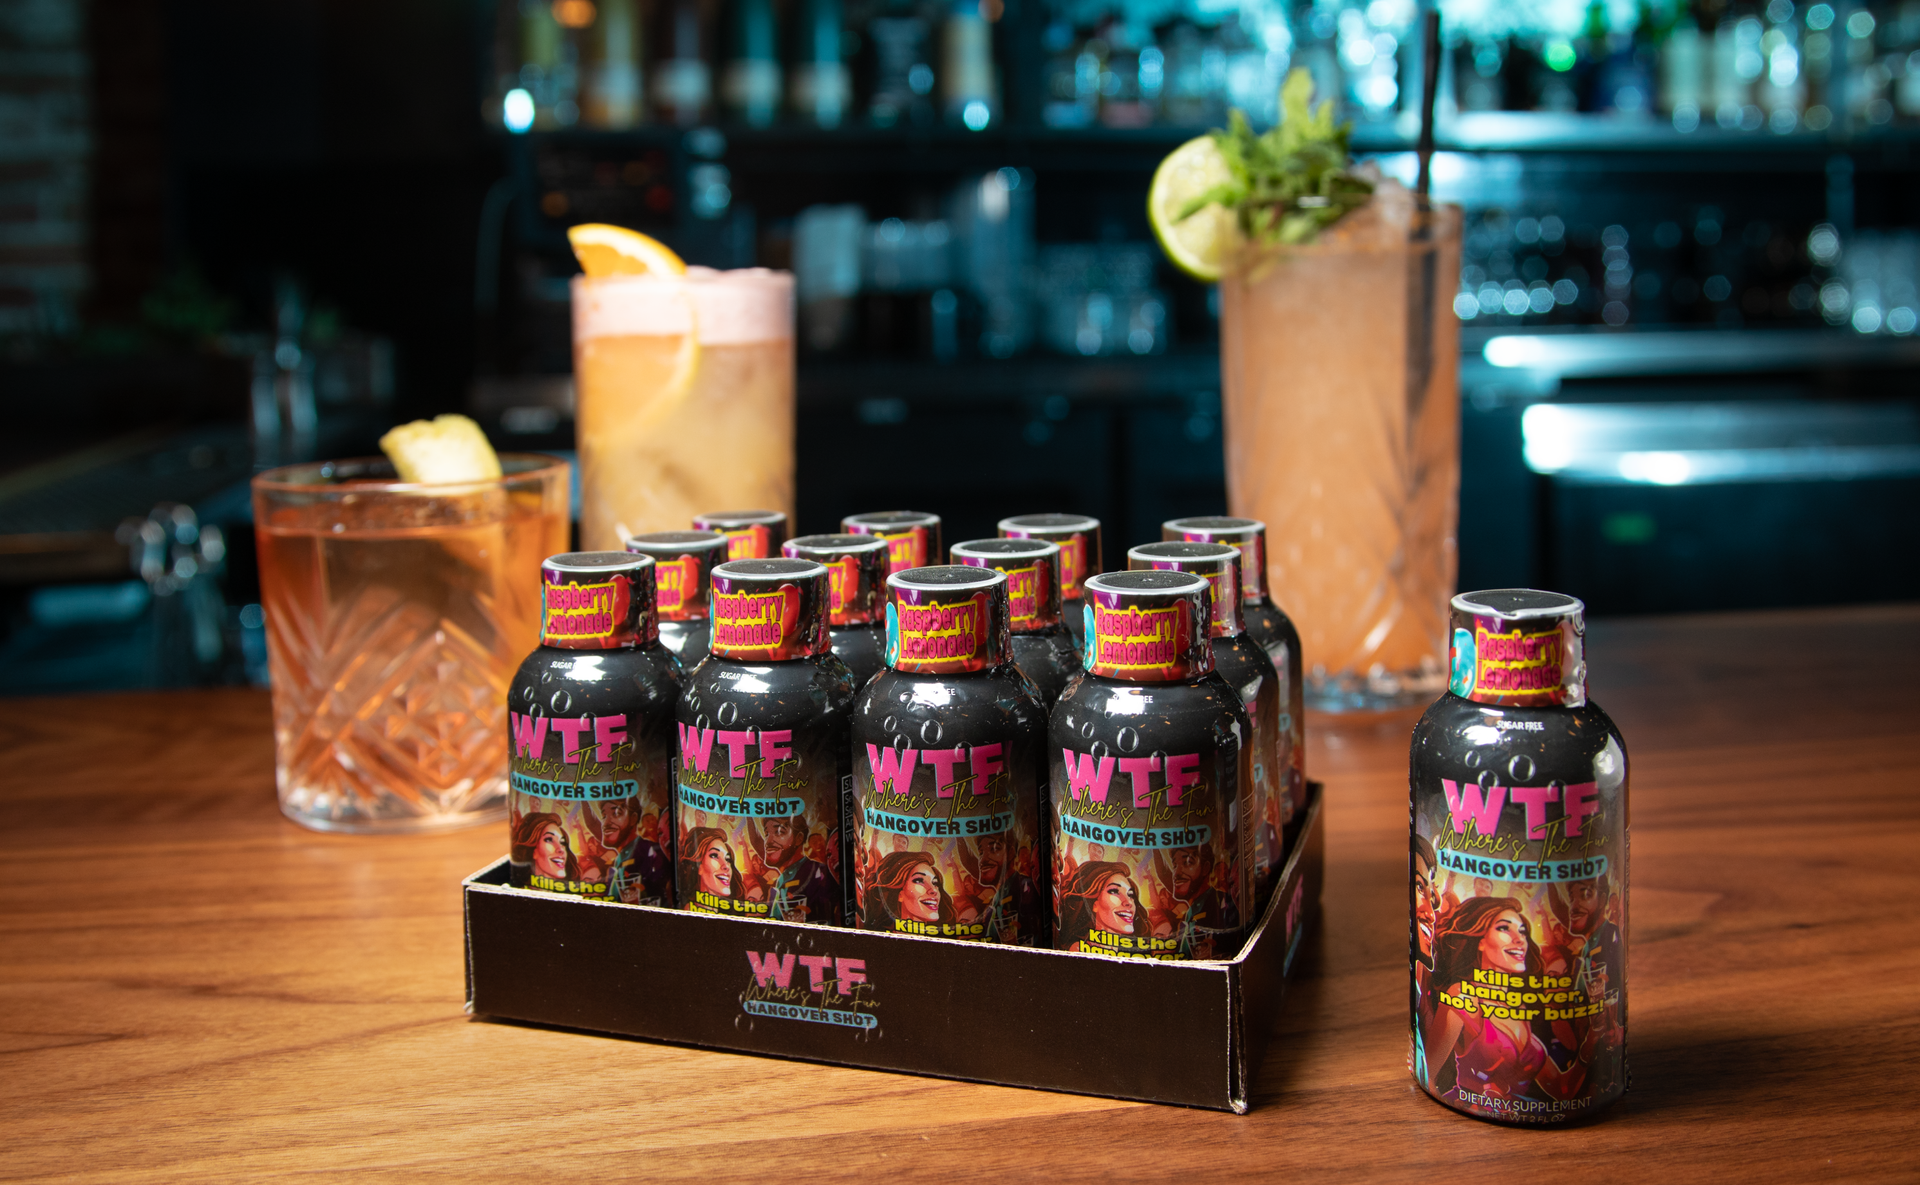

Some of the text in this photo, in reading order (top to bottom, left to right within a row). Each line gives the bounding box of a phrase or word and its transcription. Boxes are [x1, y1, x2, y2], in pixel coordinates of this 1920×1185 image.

[547, 584, 614, 614] Raspberry
[714, 592, 784, 624] Raspberry
[547, 608, 612, 635] Lemonade
[714, 618, 781, 646] Lemonade
[899, 603, 976, 637] Raspberry
[1096, 606, 1178, 642] Raspberry
[900, 629, 975, 659] Lemonade
[1096, 635, 1175, 665] Lemonade
[1478, 631, 1562, 666] Raspberry
[550, 661, 573, 669] SUGAR
[719, 671, 740, 680] SUGAR
[1477, 661, 1561, 690] Lemonade
[510, 711, 628, 764] WTF
[1496, 720, 1544, 731] SUGAR FREE
[678, 722, 793, 778] WTF
[568, 743, 603, 789] The
[608, 743, 641, 786] Fun
[866, 742, 1004, 798] WTF
[1063, 747, 1200, 808] WTF
[511, 775, 634, 799] HANGOVER SHOT
[734, 758, 766, 804] The
[770, 760, 808, 804] Fun
[679, 786, 800, 815] HANGOVER SHOT
[866, 774, 937, 819] Where's
[942, 774, 979, 825] The
[1061, 780, 1214, 835] Where's The Fun
[1441, 778, 1599, 840] WTF
[866, 810, 960, 835] HANGOVER
[965, 814, 1012, 834] SHOT
[1062, 816, 1208, 846] HANGOVER SHOT
[1439, 812, 1611, 869] Where's The Fun
[1440, 850, 1604, 879] HANGOVER SHOT
[530, 875, 607, 893] Kills the
[696, 891, 730, 910] Kills
[733, 899, 768, 913] the
[895, 918, 984, 936] Kills the
[1089, 929, 1177, 950] Kills the
[746, 950, 867, 995] WTF
[1473, 968, 1572, 989] Kills the
[745, 973, 881, 1016] Where's The Fun
[1439, 992, 1604, 1021] not your buzz!
[1461, 981, 1585, 1007] hangover,
[748, 1001, 874, 1026] HANGOVER SHOT
[1459, 1089, 1592, 1112] DIETARY SUPPLEMENT
[1486, 1111, 1506, 1119] NET
[1509, 1113, 1526, 1122] WT
